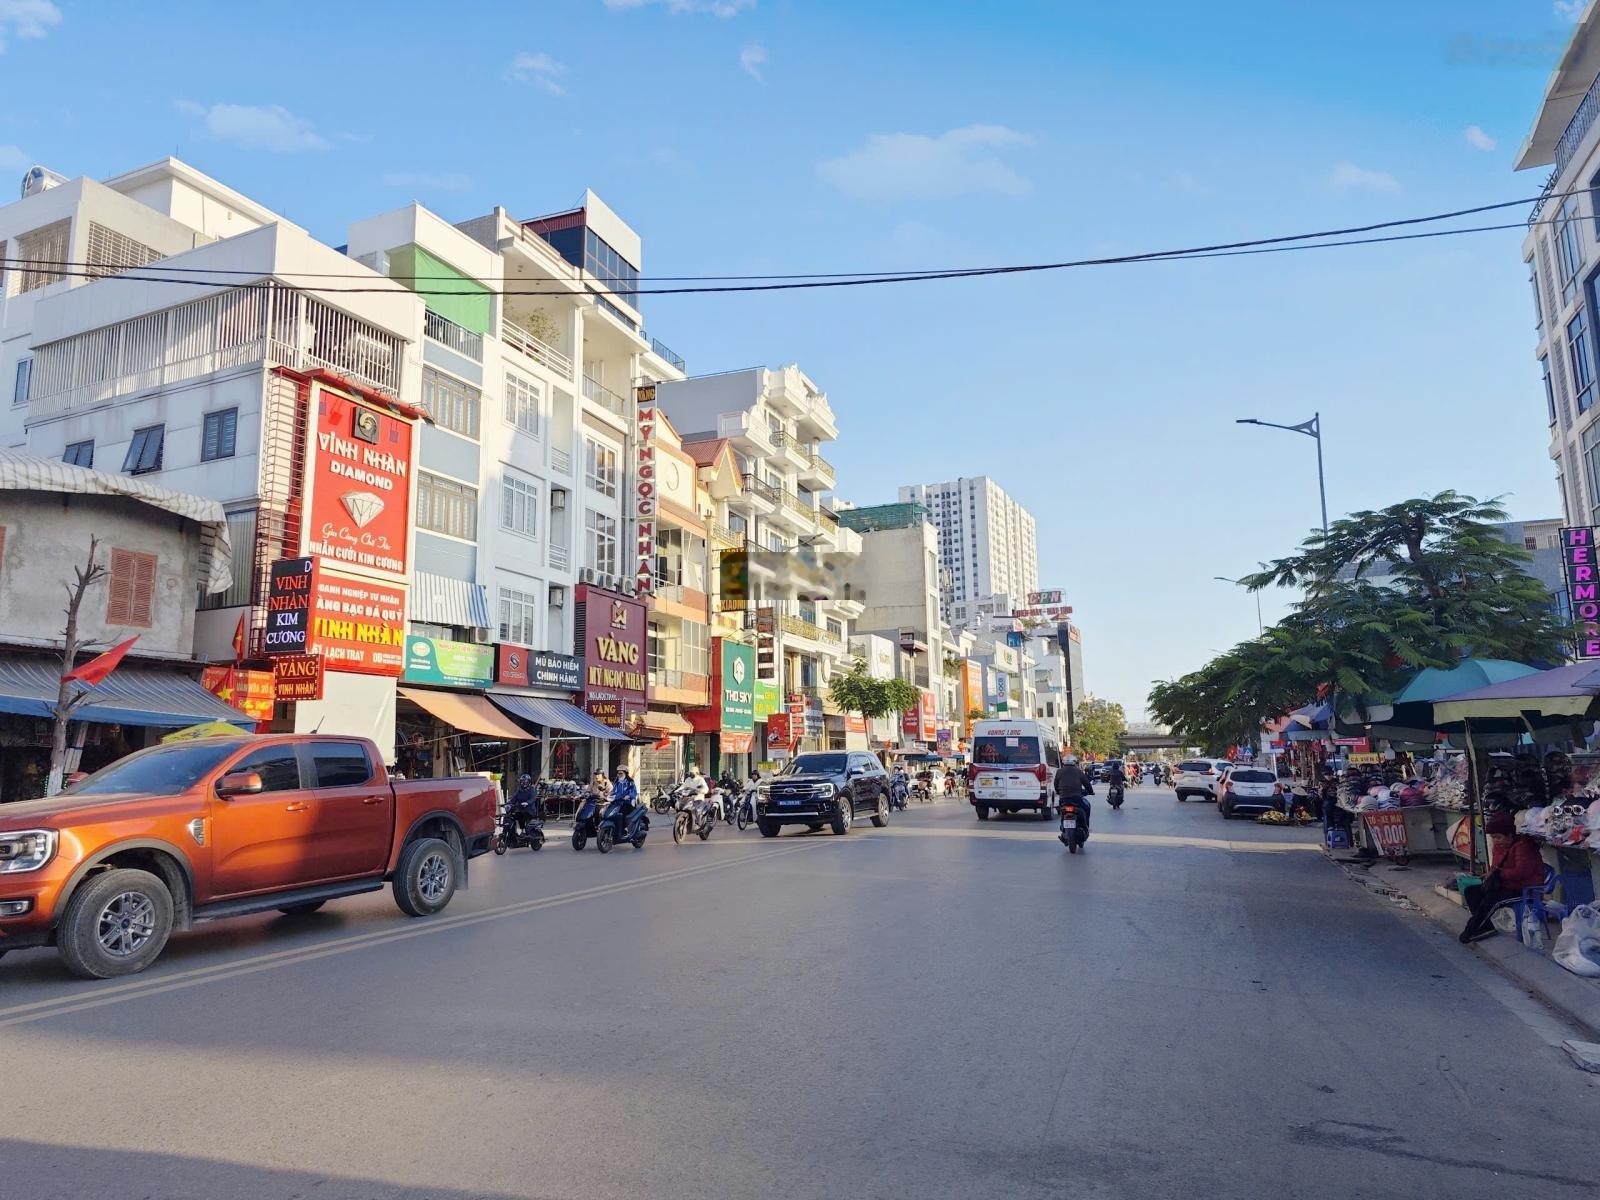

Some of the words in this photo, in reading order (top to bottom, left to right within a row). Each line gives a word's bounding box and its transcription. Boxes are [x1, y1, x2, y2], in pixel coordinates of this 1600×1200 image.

[330, 459, 393, 491] DIAMOND
[358, 552, 374, 566] KIM
[318, 583, 341, 595] OANH
[316, 594, 341, 611] ÀNG
[342, 602, 364, 616] BẠC
[276, 612, 299, 626] KIM
[356, 621, 403, 647] NHÀN
[346, 648, 364, 661] TRAY
[597, 632, 639, 665] VÀNG
[279, 659, 316, 677] VÀNG
[592, 703, 616, 714] VÀNG
